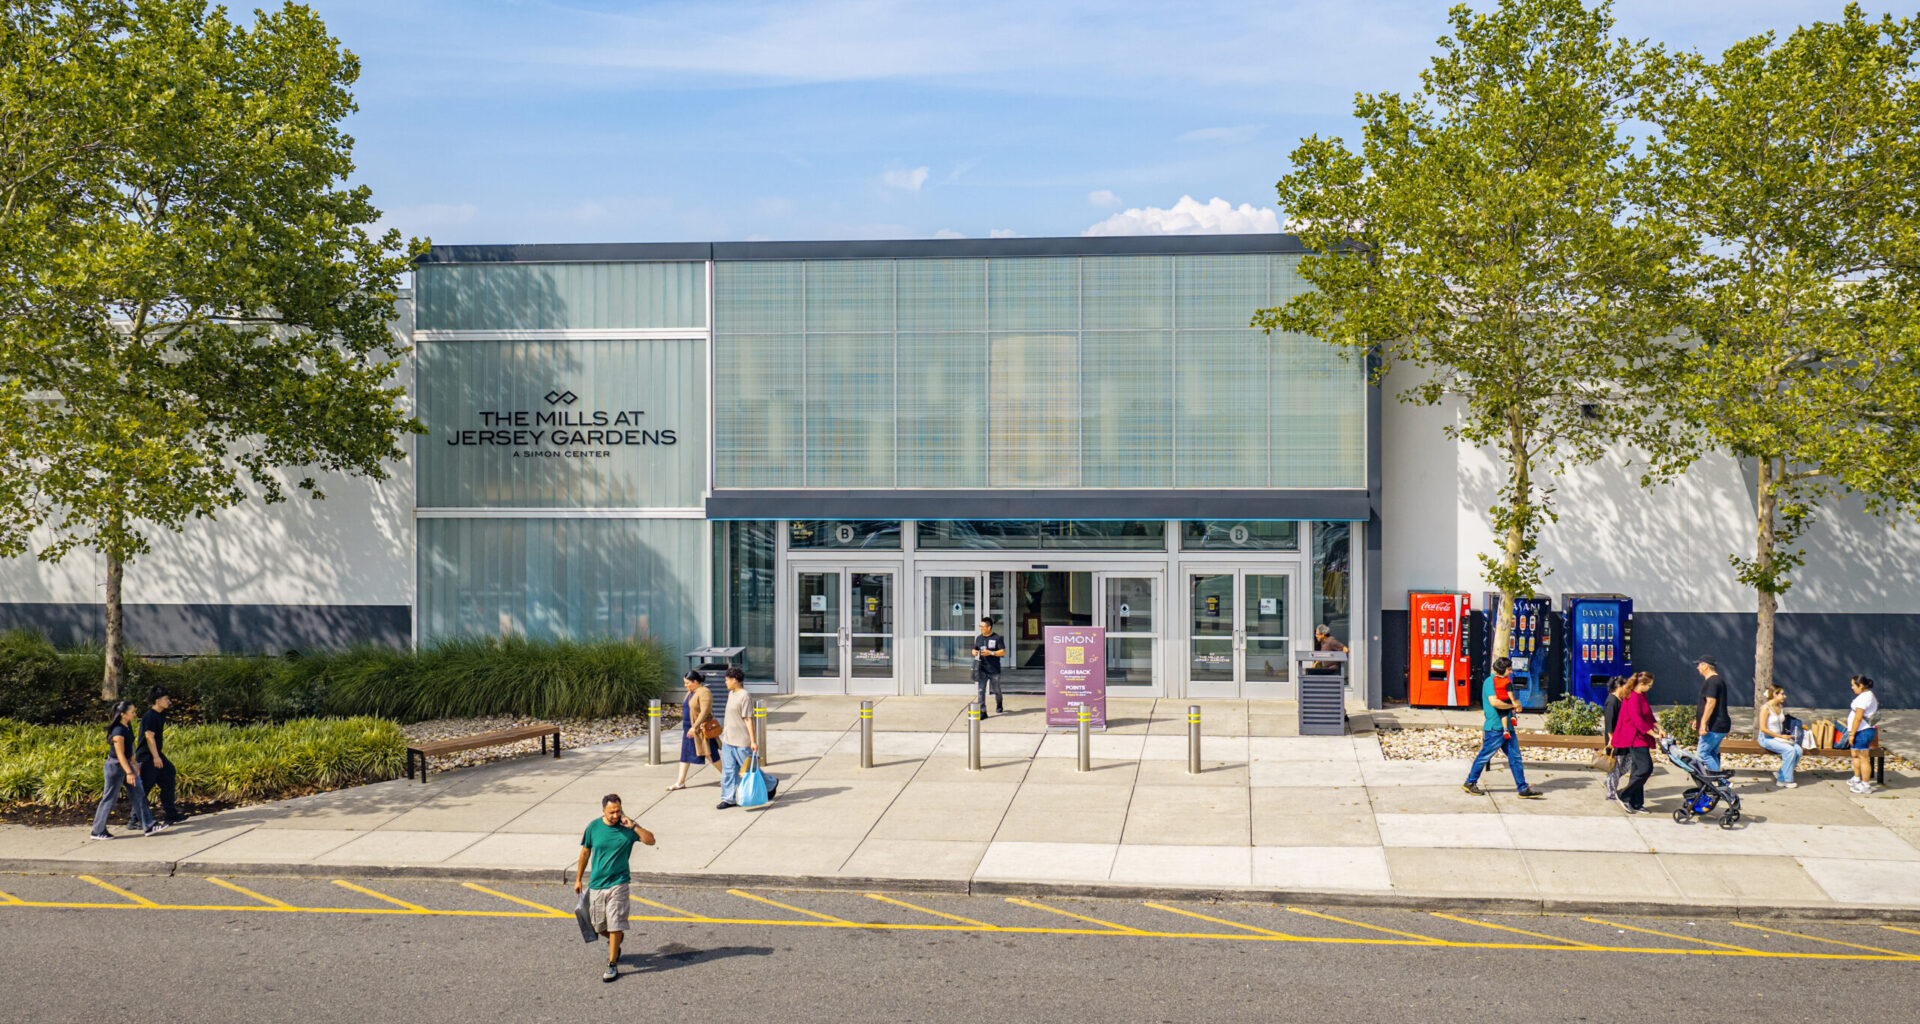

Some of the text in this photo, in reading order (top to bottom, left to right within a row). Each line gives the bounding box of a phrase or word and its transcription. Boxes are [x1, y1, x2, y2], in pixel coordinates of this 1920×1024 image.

[479, 411, 645, 426] THE MILLS AT
[447, 430, 677, 446] JERSEY GARDENS
[513, 450, 610, 458] A SIMON CENTER
[841, 528, 849, 539] B
[1235, 529, 1244, 540] B
[1513, 600, 1540, 612] ASANI
[1582, 609, 1613, 617] DASANI
[1053, 635, 1094, 644] SIMON
